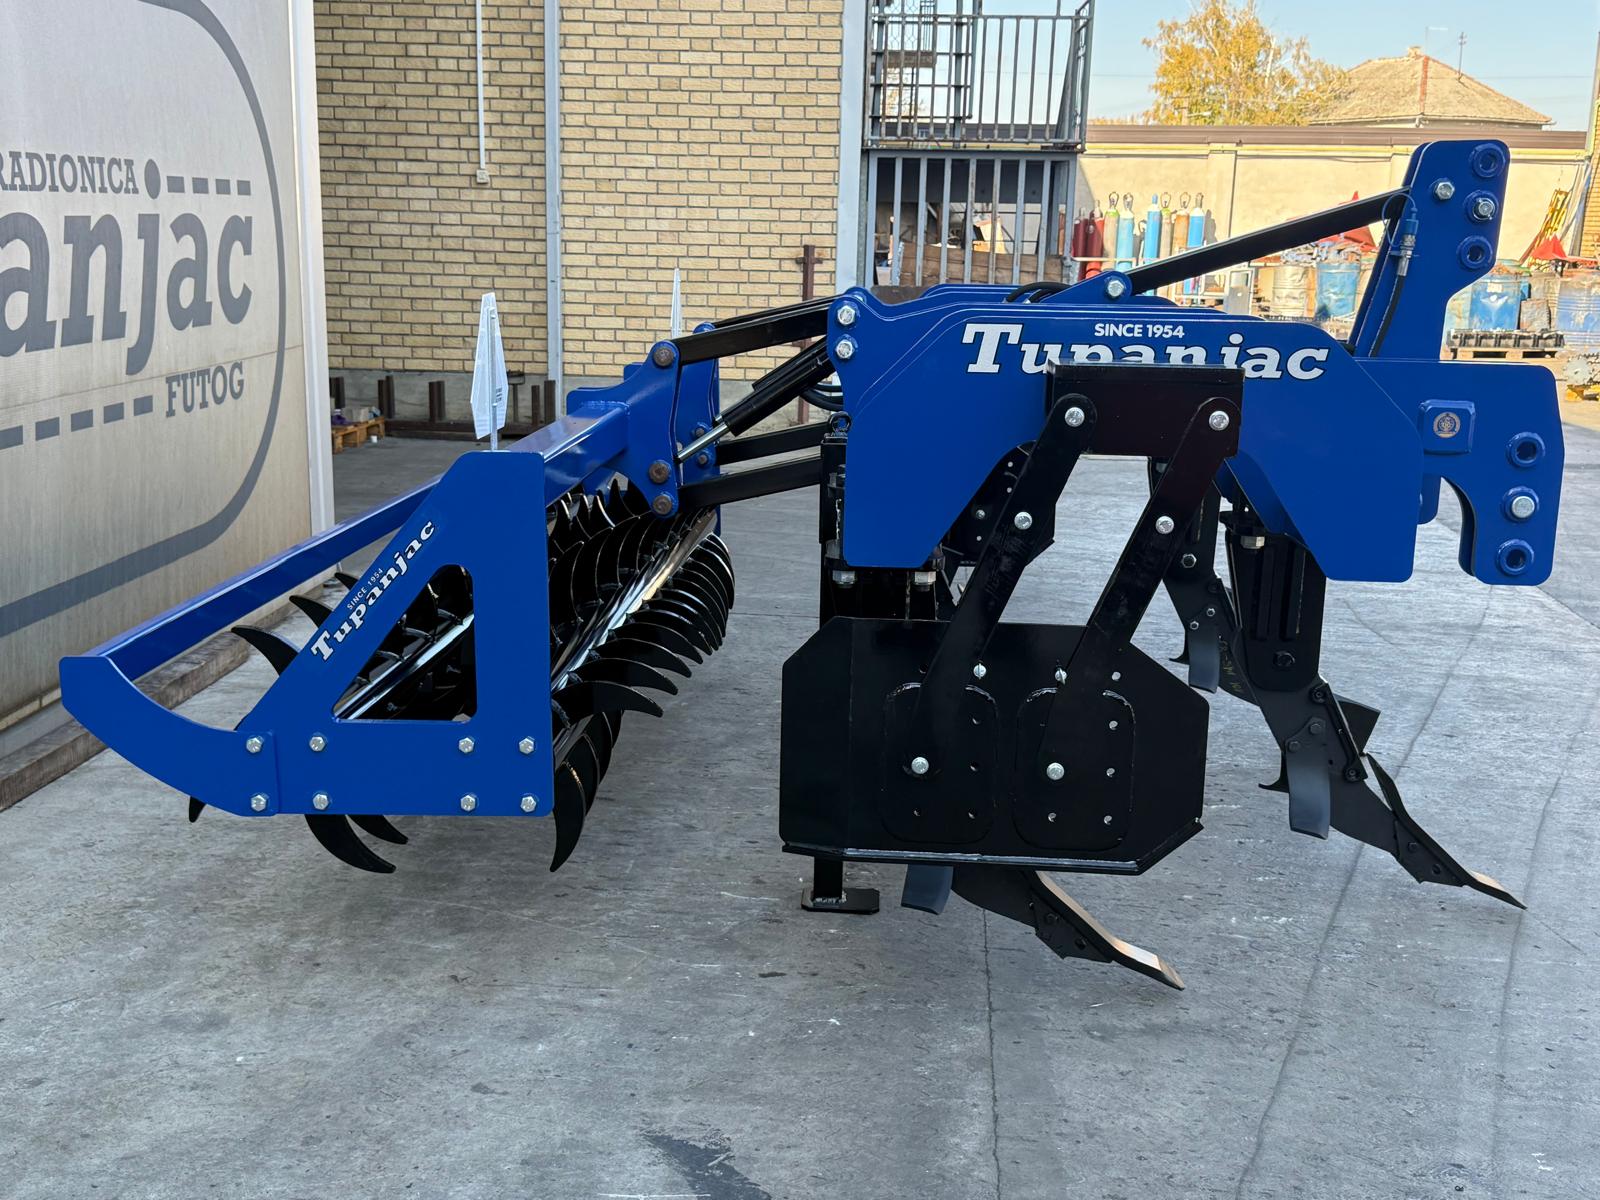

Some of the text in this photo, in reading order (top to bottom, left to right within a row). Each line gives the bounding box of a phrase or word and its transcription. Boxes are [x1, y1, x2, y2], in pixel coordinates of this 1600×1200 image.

[1094, 323, 1185, 338] SINCE 1954
[165, 361, 245, 418] FUTOG
[310, 521, 435, 661] Tupanjac
[347, 568, 383, 610] SINCE 1954
